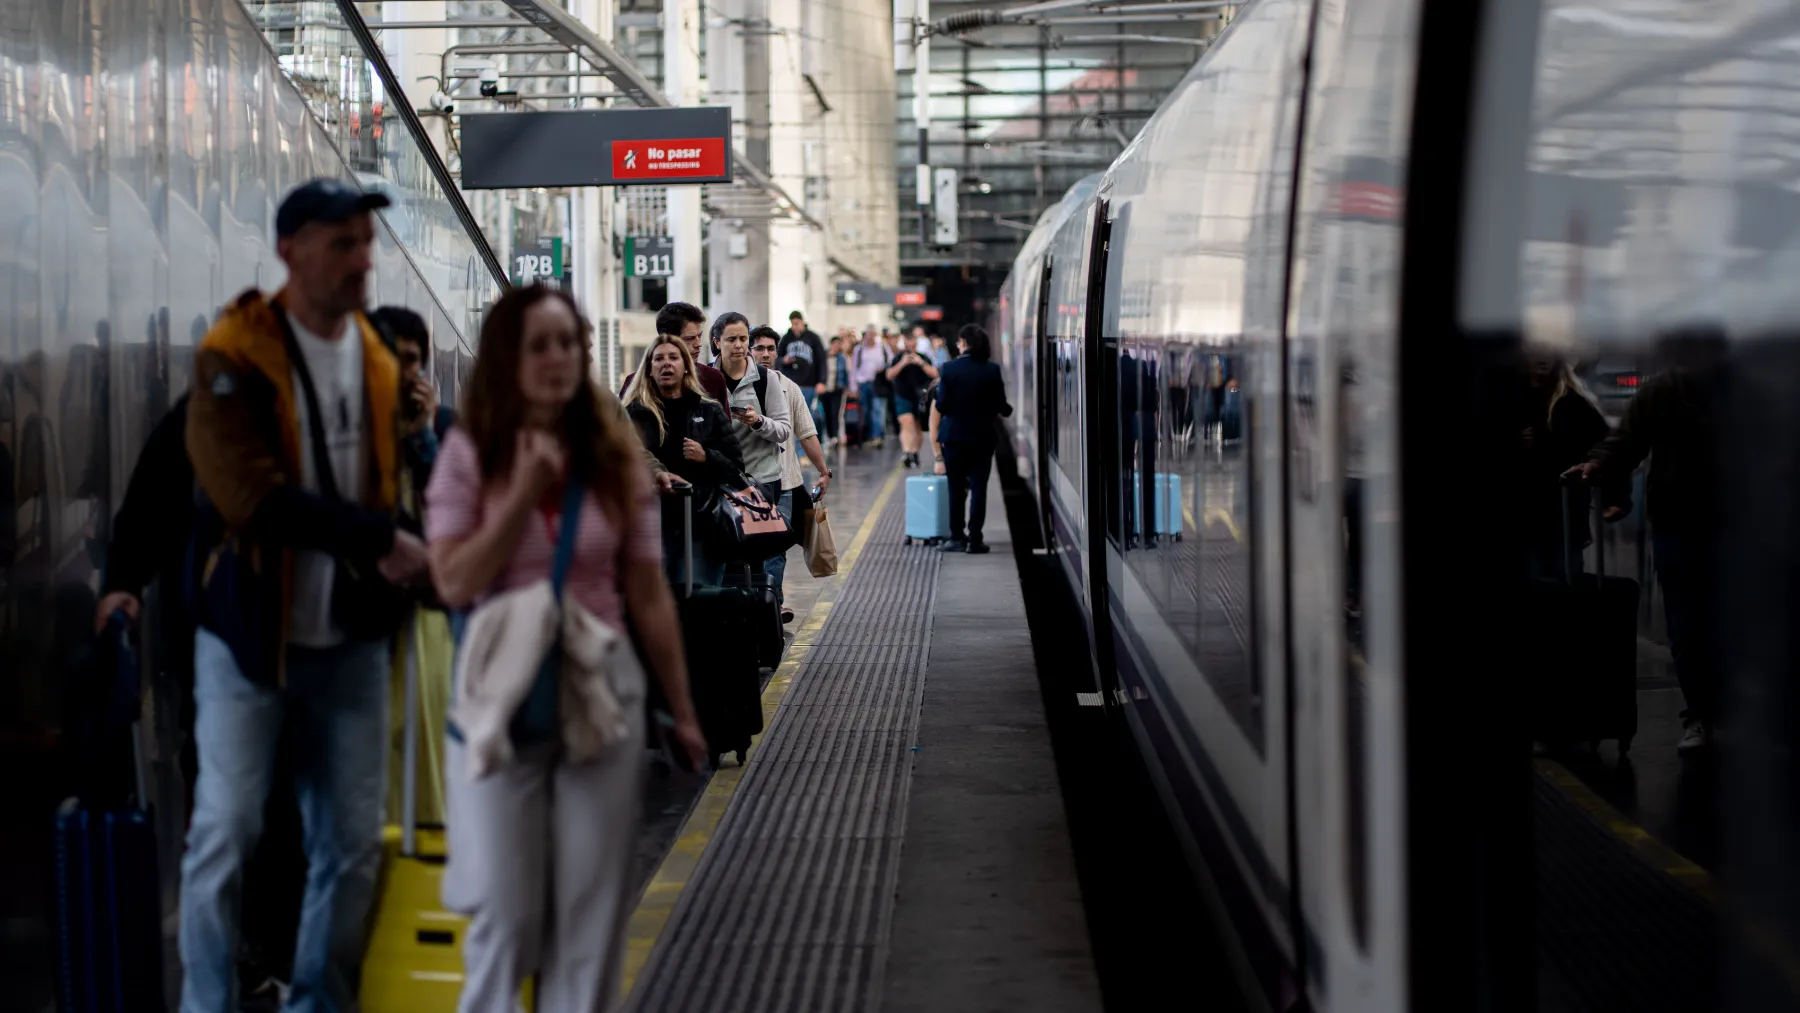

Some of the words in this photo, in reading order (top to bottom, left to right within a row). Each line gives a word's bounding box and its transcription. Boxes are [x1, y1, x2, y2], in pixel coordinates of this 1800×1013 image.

[648, 147, 665, 160] No
[667, 147, 702, 161] pasar
[634, 254, 673, 276] B11
